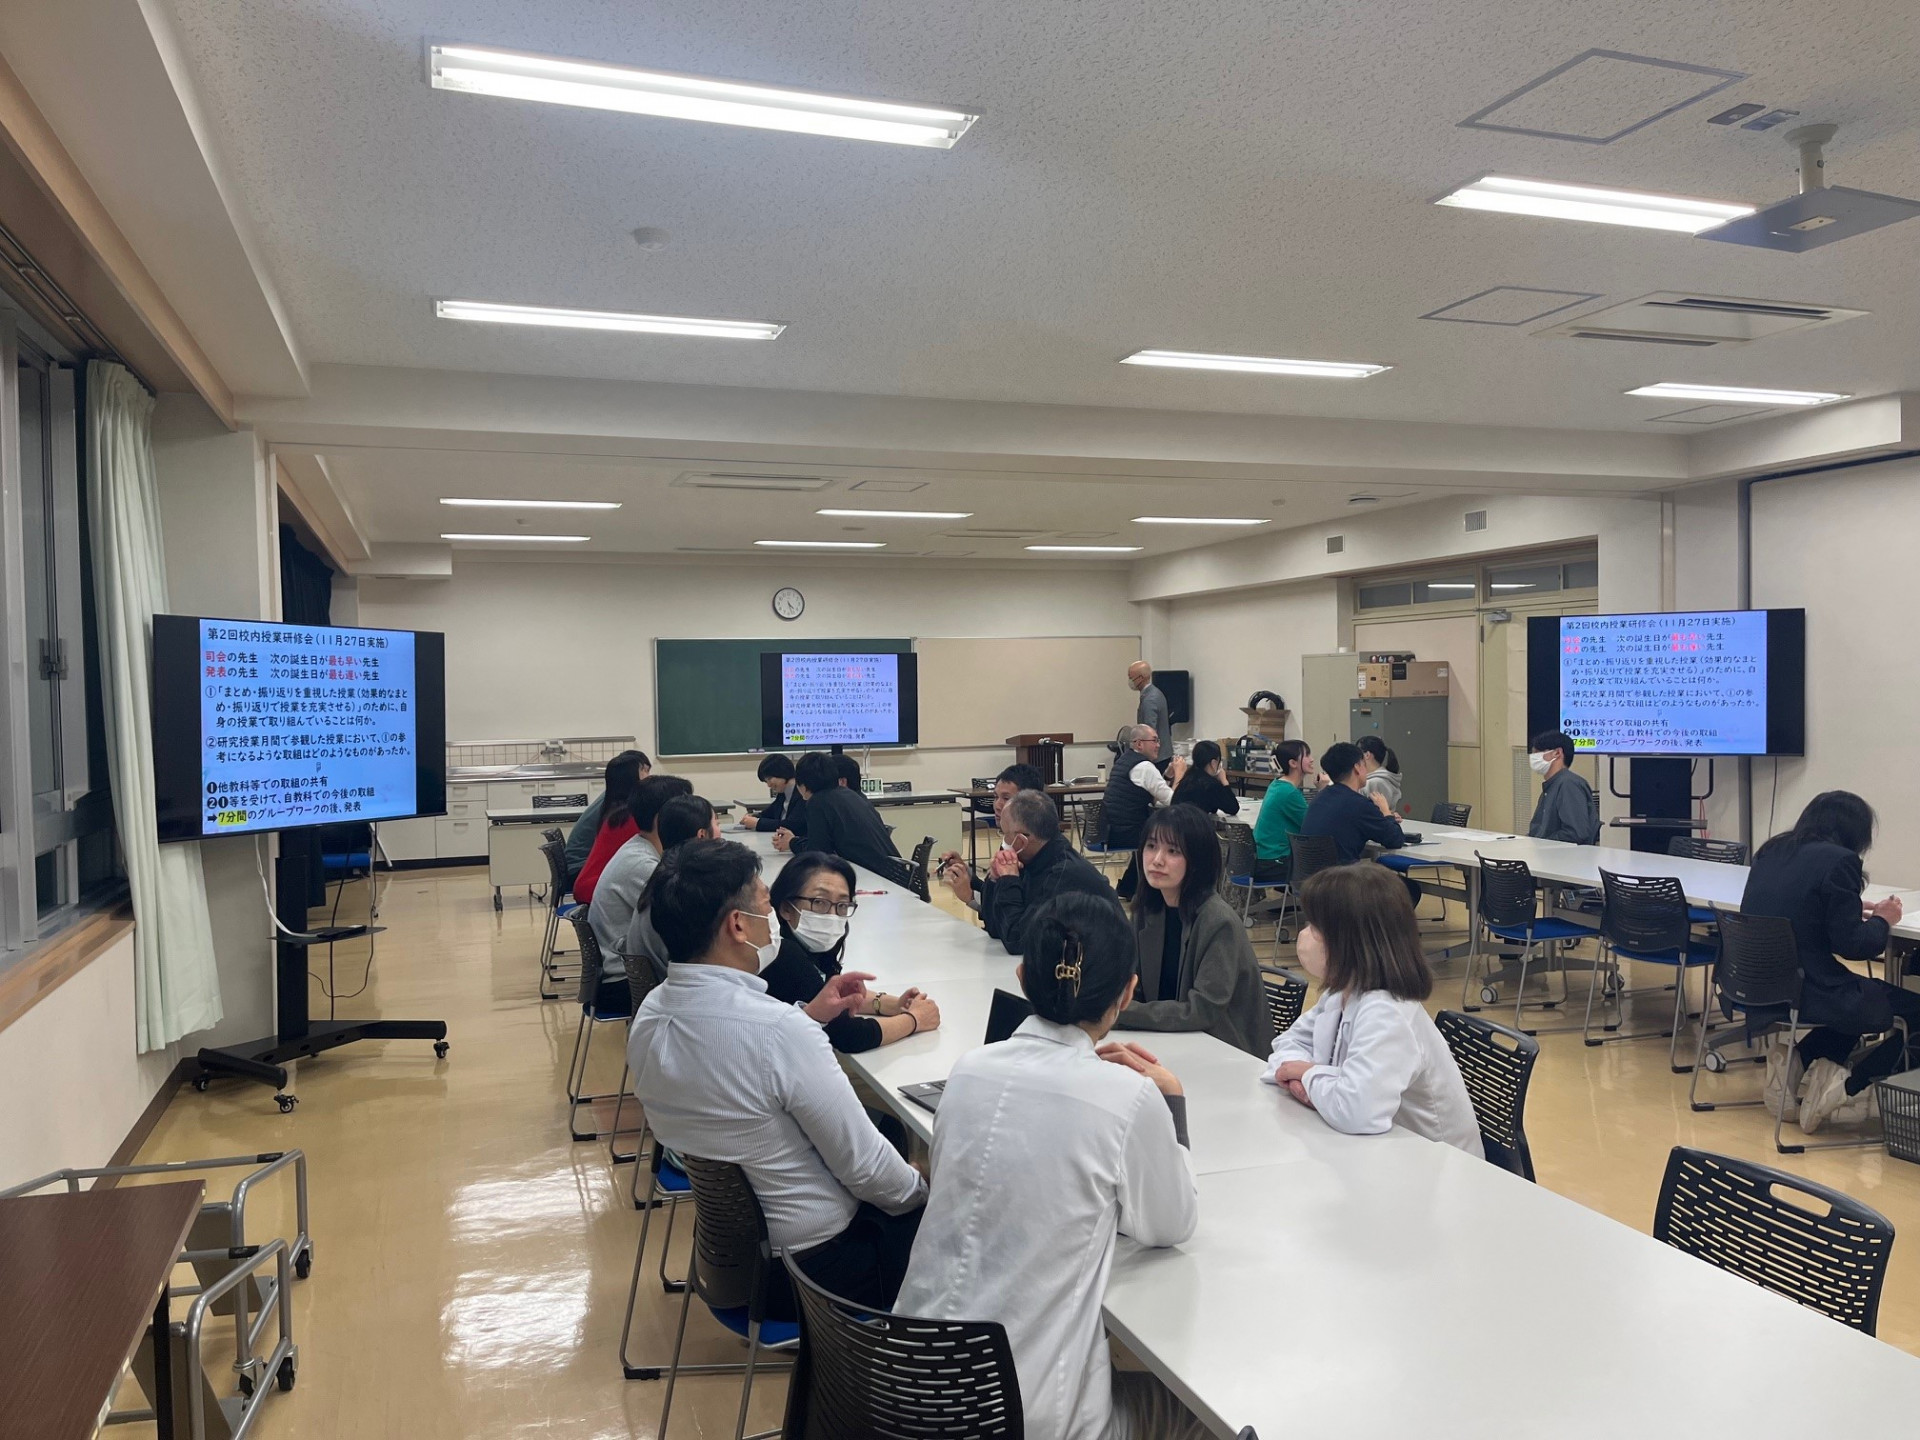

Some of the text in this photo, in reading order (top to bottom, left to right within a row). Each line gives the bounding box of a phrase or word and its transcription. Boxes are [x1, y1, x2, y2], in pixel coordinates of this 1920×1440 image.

[208, 628, 389, 648] 第2回校内授業研修会（11月27日実施）
[205, 651, 379, 667] 司会の先生 次の誕生日が最も早い先生
[205, 667, 379, 681] 発表の先生 次の誕生日が最も遅い先生
[216, 716, 376, 728] 身の授業で取り組んでいることは何か。
[216, 746, 411, 762] 考になるような取組はどのようなものがあったか。
